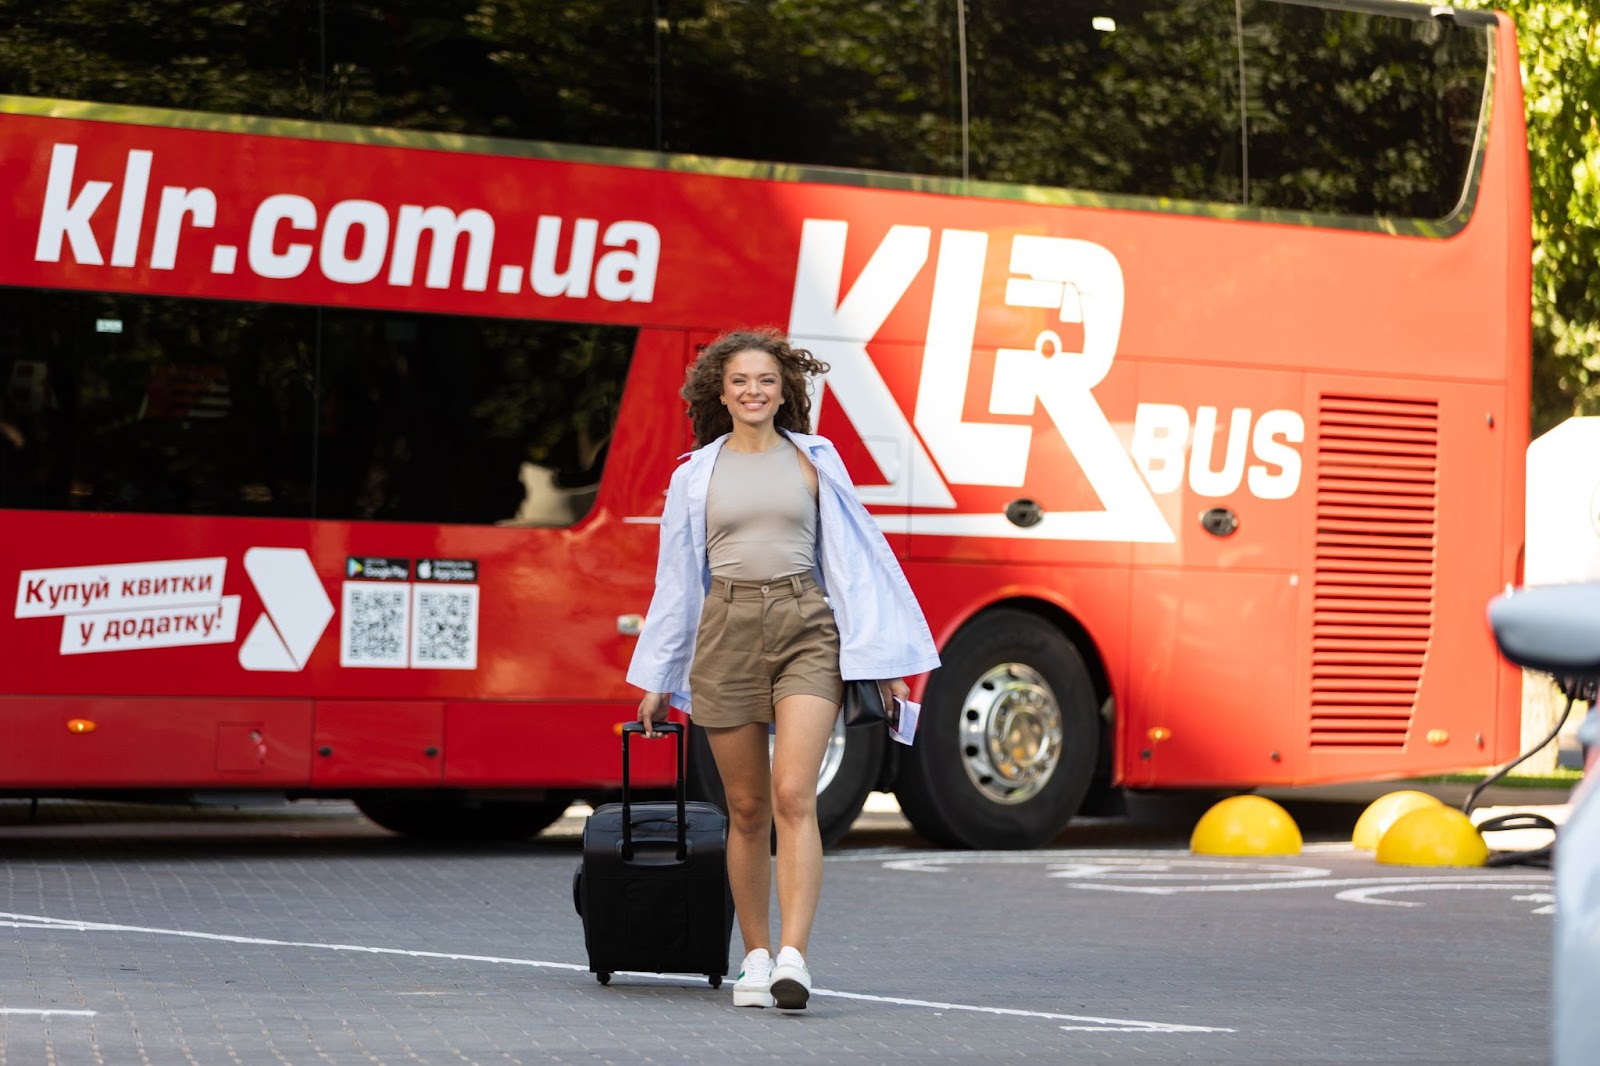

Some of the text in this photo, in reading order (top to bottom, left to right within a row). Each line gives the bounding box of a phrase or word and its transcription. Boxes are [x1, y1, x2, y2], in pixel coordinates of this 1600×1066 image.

[35, 142, 661, 303] klr.com.ua
[786, 217, 1177, 544] KLR
[1131, 402, 1306, 500] BUS
[25, 574, 213, 609] Купуй квитки
[80, 606, 223, 646] у додатку!
